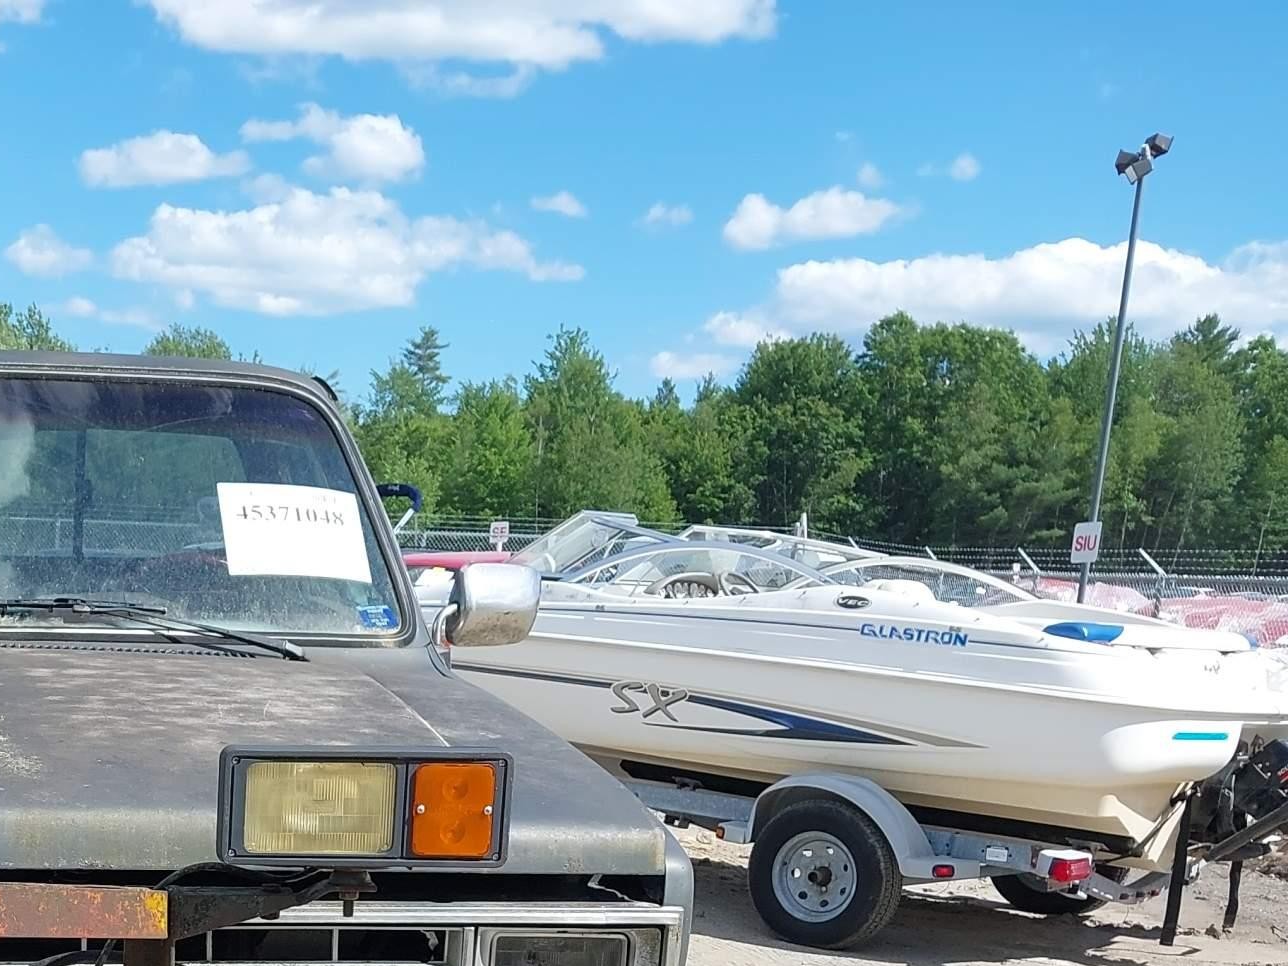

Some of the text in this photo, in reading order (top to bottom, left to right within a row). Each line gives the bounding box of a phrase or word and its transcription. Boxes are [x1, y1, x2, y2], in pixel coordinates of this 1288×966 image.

[236, 504, 345, 527] 45371048
[1074, 534, 1098, 552] SIU
[837, 597, 869, 607] VEC
[860, 623, 969, 647] GLASTRON
[610, 681, 689, 723] SX
